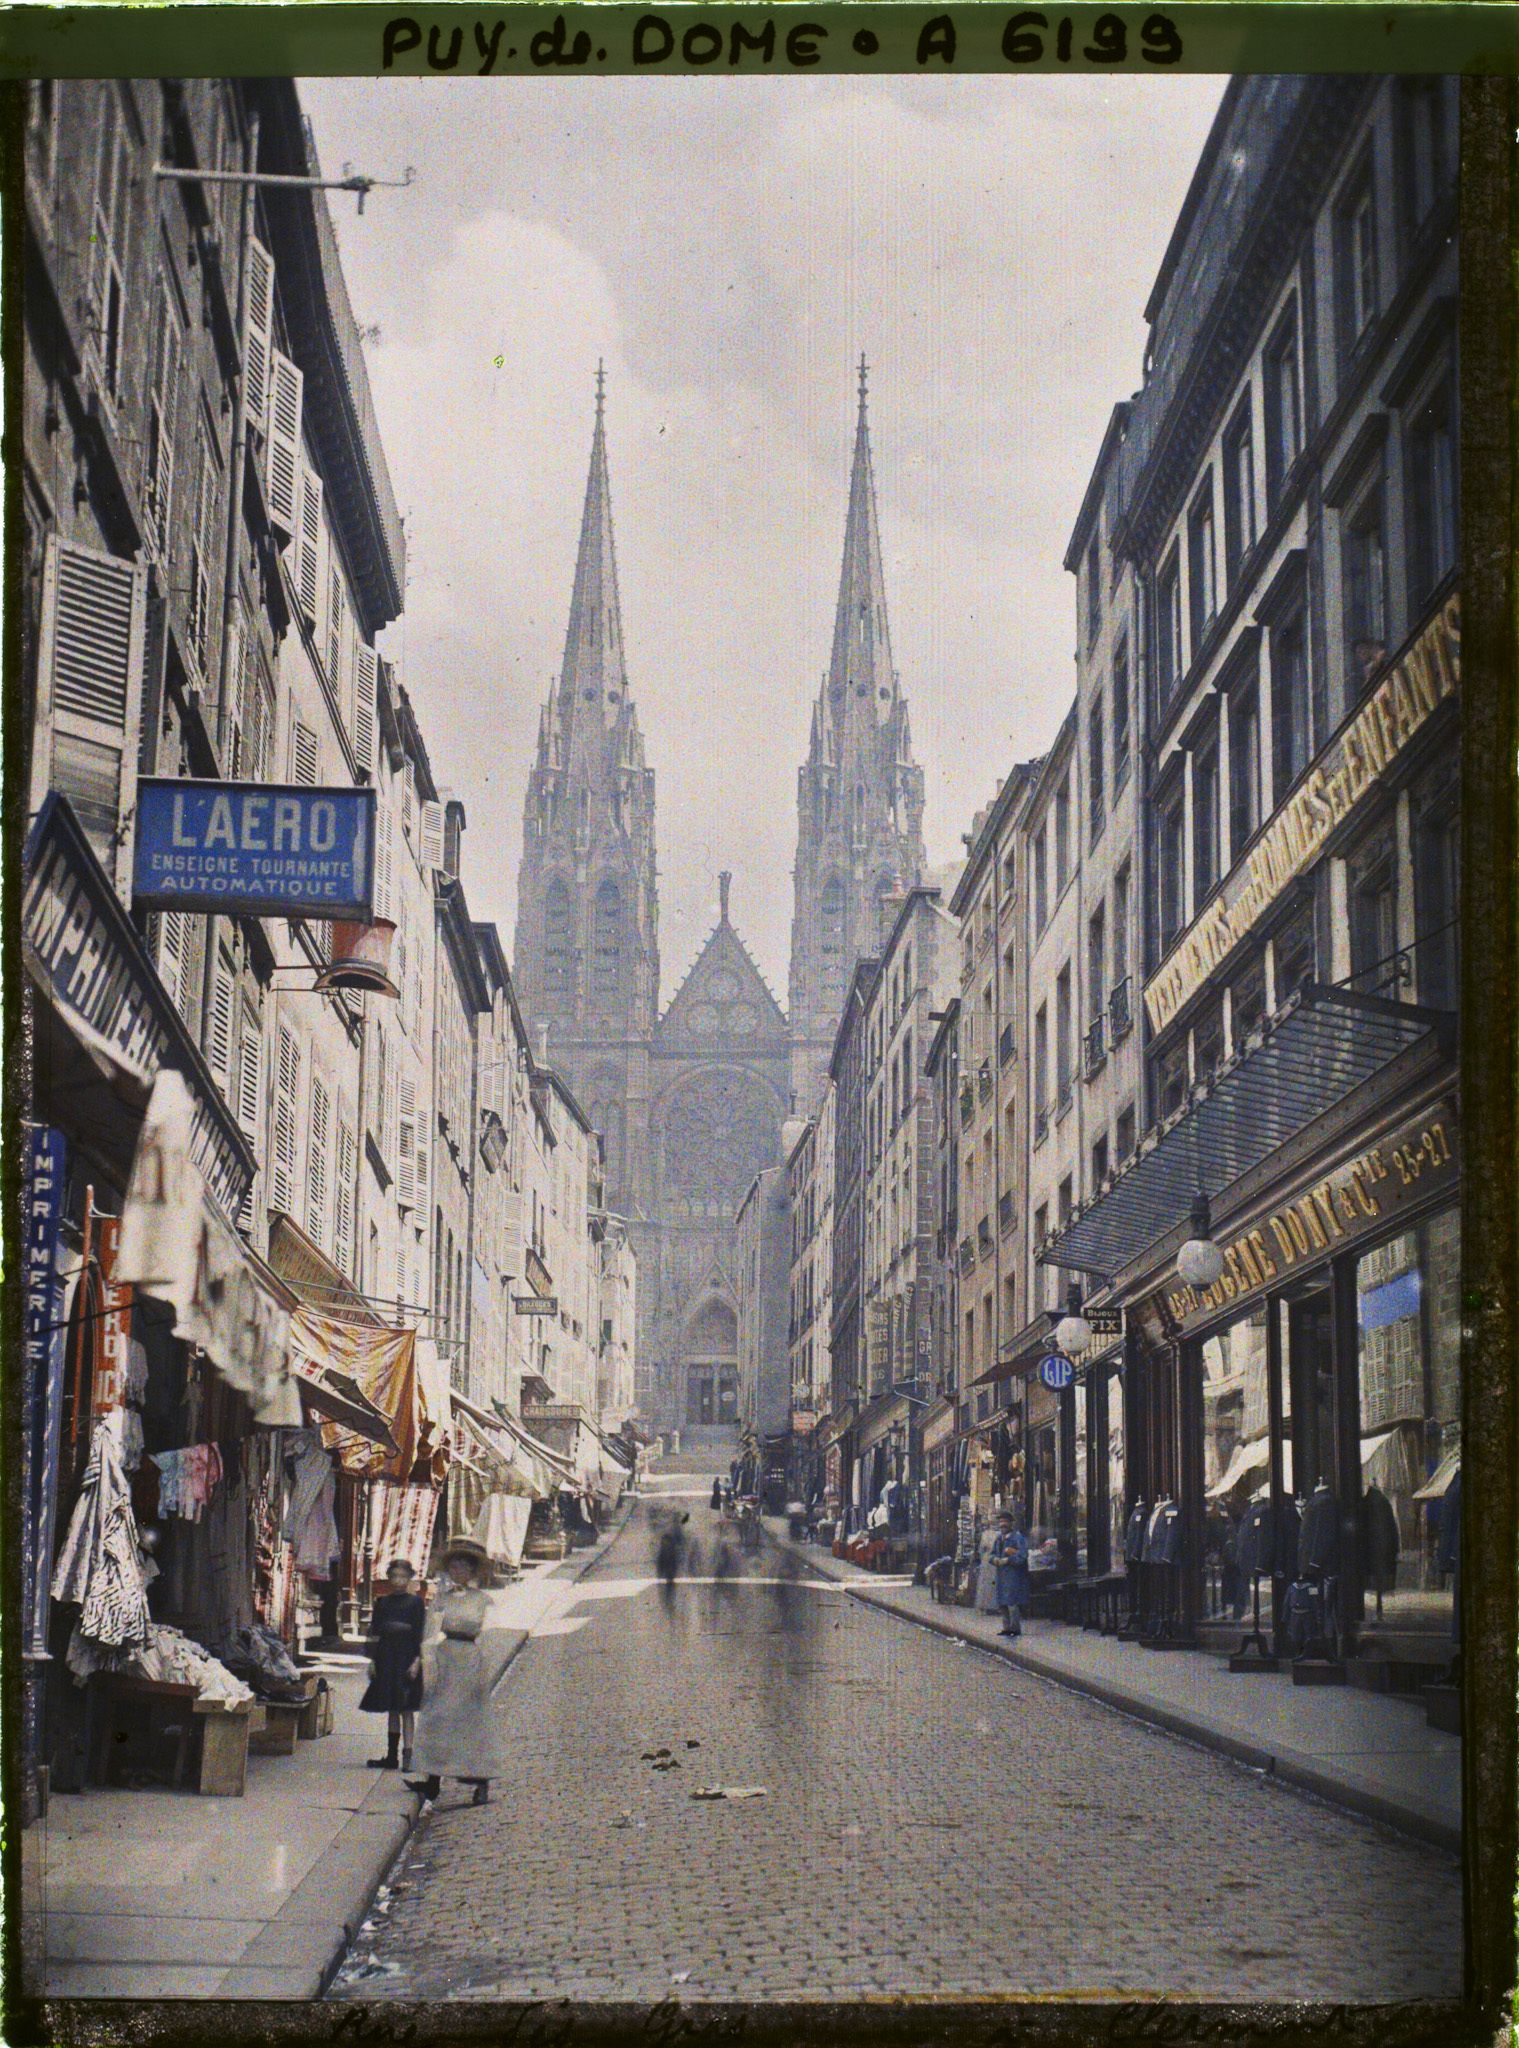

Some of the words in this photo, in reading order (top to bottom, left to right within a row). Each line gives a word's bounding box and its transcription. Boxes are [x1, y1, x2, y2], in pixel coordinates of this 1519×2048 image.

[916, 14, 957, 65] A
[1001, 11, 1183, 65] 6199
[152, 854, 239, 874] ENSEIGNE
[252, 858, 350, 878] TOURNANTE
[161, 876, 337, 896] AUTOMATIQUE
[23, 836, 168, 1076] IMPRIMERIE
[1392, 1123, 1451, 1185] 25-27
[26, 1131, 54, 1360] IMPRIMERIE
[1089, 1319, 1118, 1331] FIX
